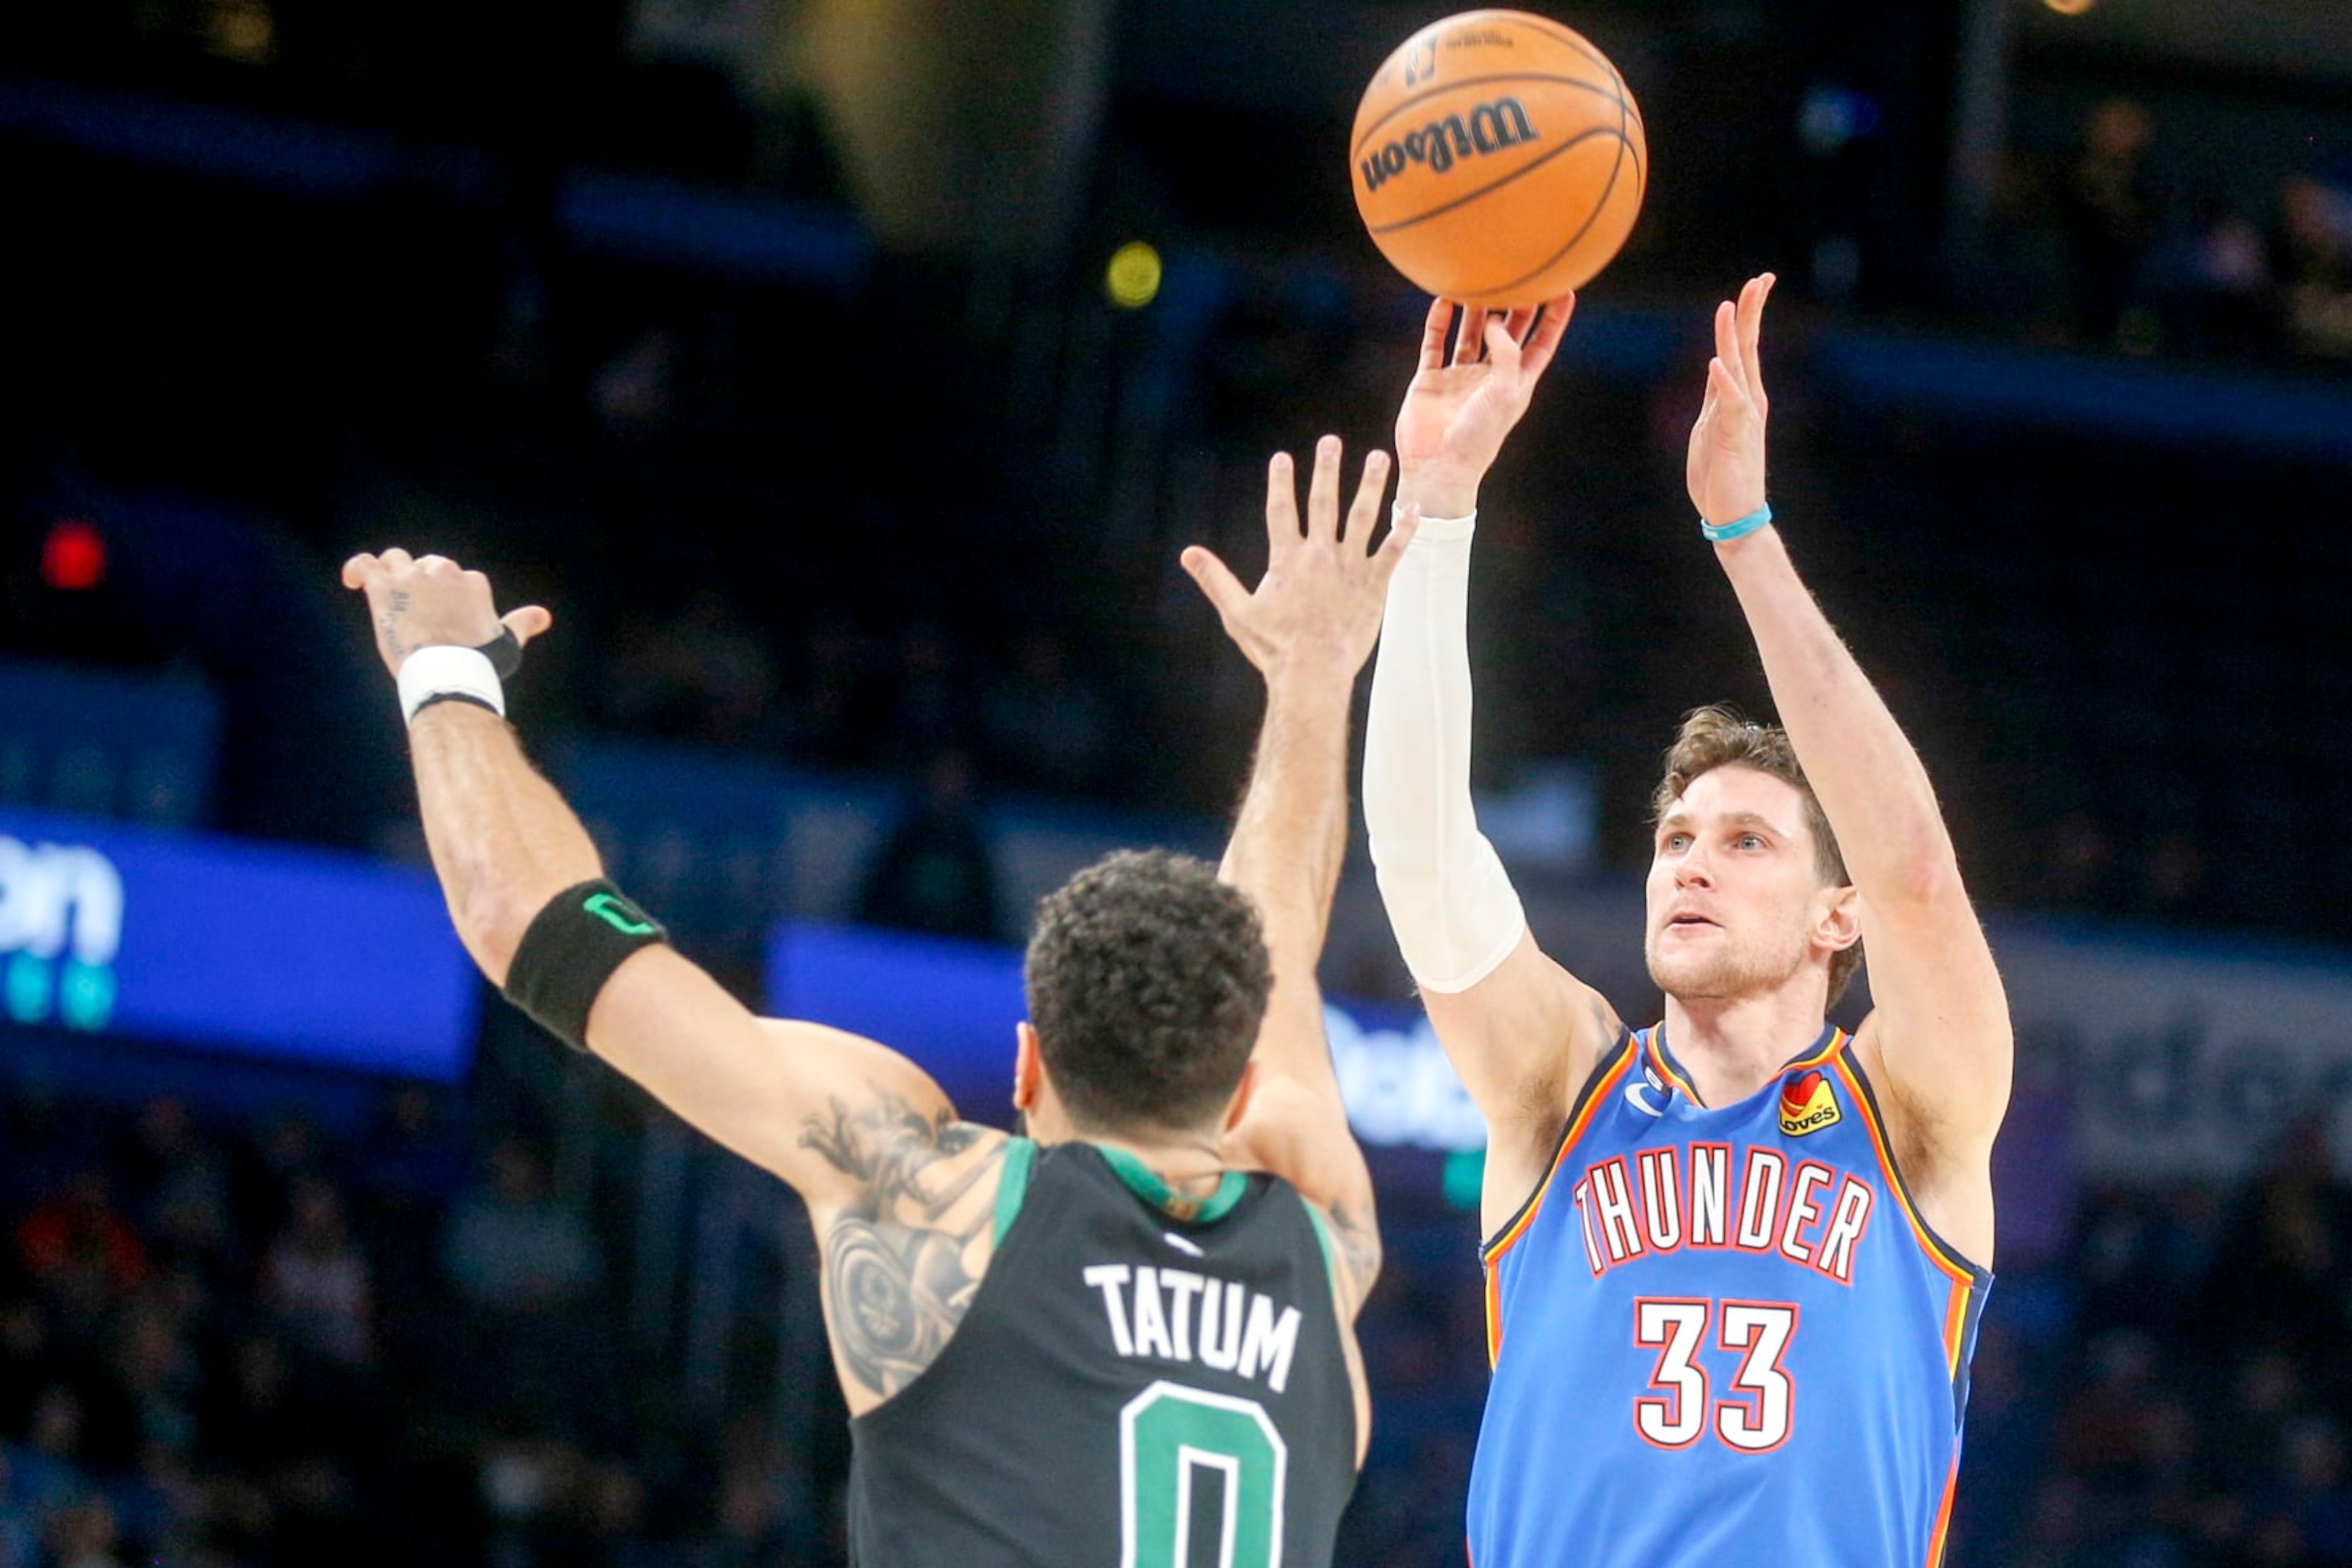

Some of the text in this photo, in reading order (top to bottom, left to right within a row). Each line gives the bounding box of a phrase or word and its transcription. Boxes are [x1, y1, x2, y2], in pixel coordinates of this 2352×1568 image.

[1361, 96, 1539, 193] Wilson
[1574, 1141, 1875, 1287] THUNDER
[1083, 1264, 1302, 1393] TATUM
[1633, 1296, 1800, 1456] 33
[1120, 1380, 1287, 1568] 0
